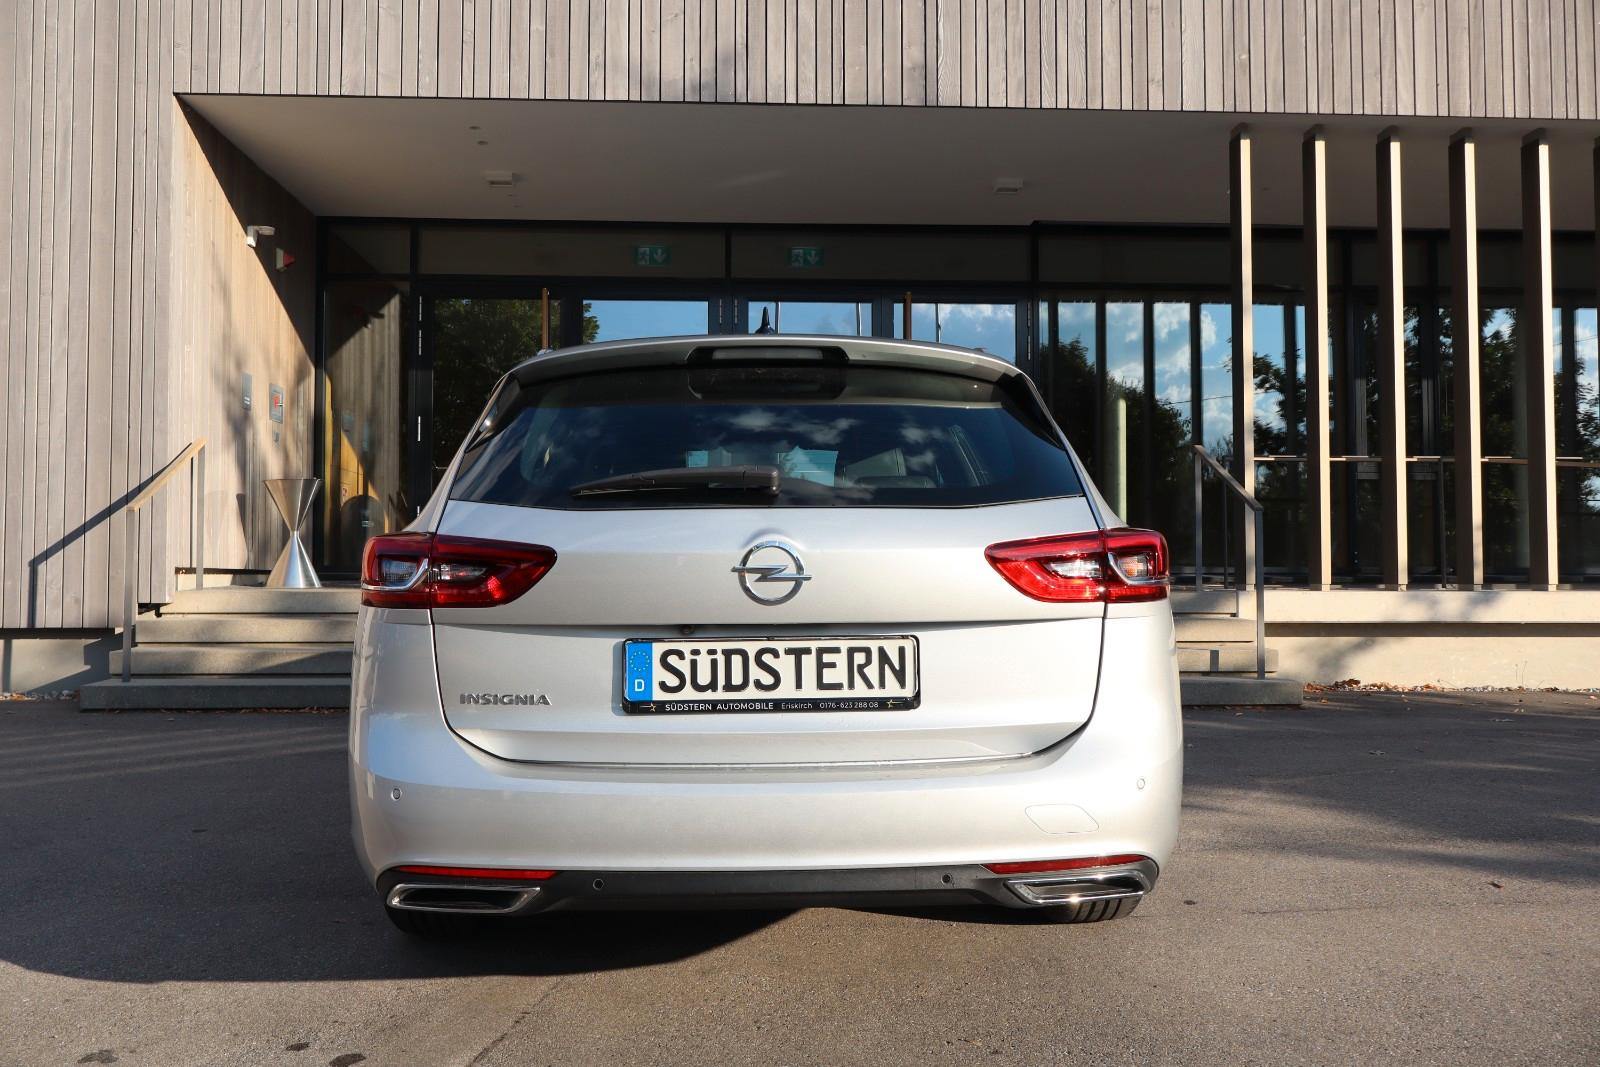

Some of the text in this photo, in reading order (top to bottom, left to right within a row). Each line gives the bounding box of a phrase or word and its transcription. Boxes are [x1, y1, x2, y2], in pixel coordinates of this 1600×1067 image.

[634, 679, 645, 691] D
[460, 693, 552, 706] INSIGNIA
[665, 702, 712, 711] SÜDSTERN
[716, 702, 774, 710] AUTOMOBILE
[781, 702, 813, 710] Eriskirch
